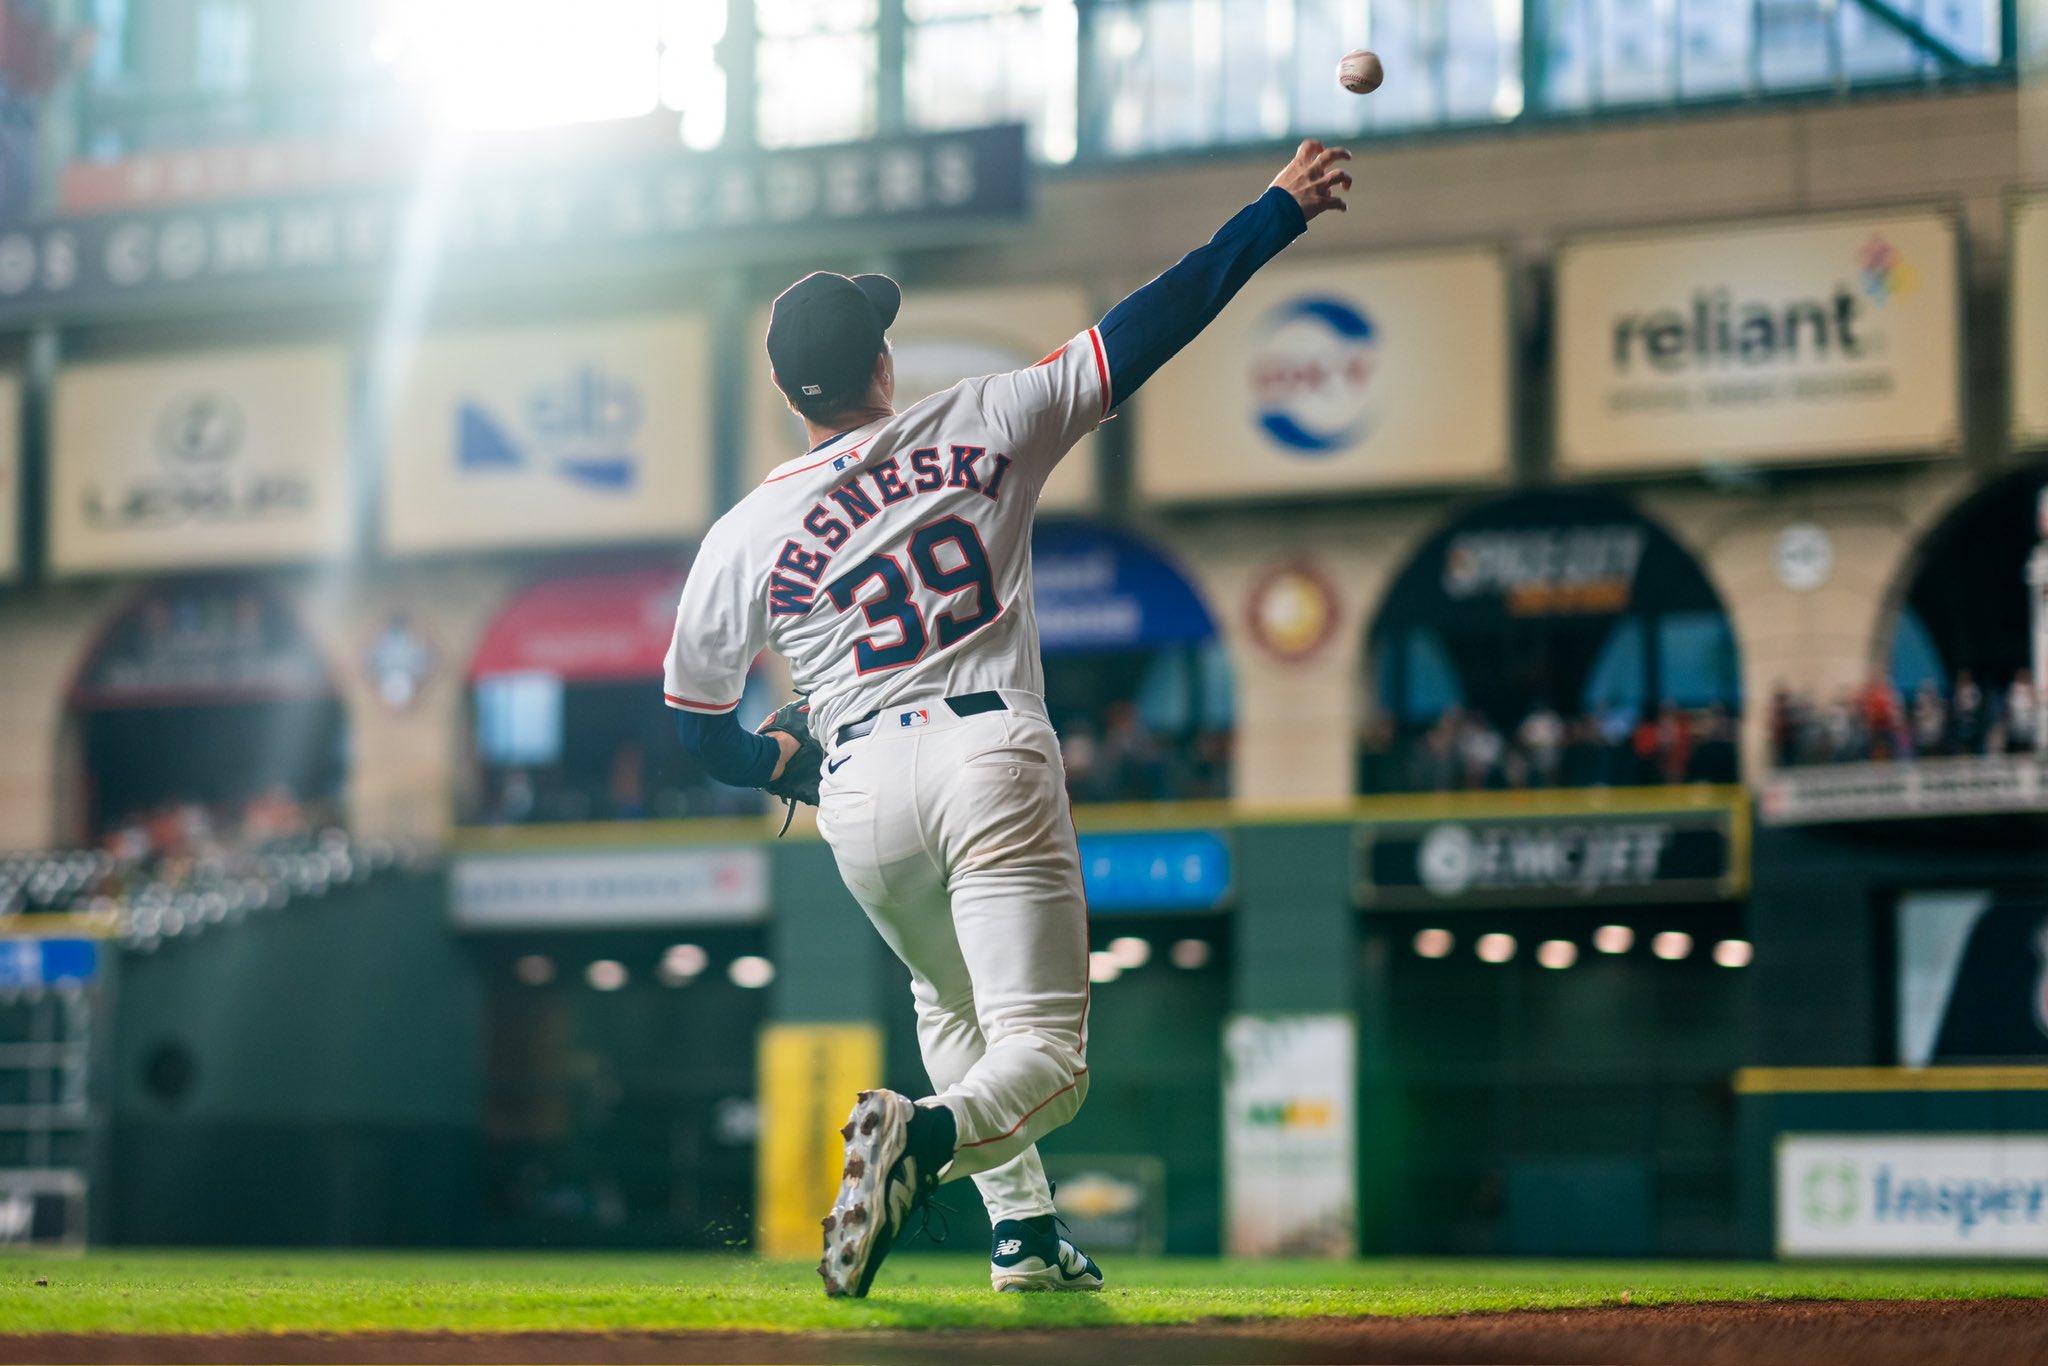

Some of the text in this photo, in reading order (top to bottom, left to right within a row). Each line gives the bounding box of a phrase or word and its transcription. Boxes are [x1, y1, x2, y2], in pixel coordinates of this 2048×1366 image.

[1610, 281, 1866, 372] reliant
[769, 444, 1012, 617] WESNESKI
[825, 514, 1004, 676] 39
